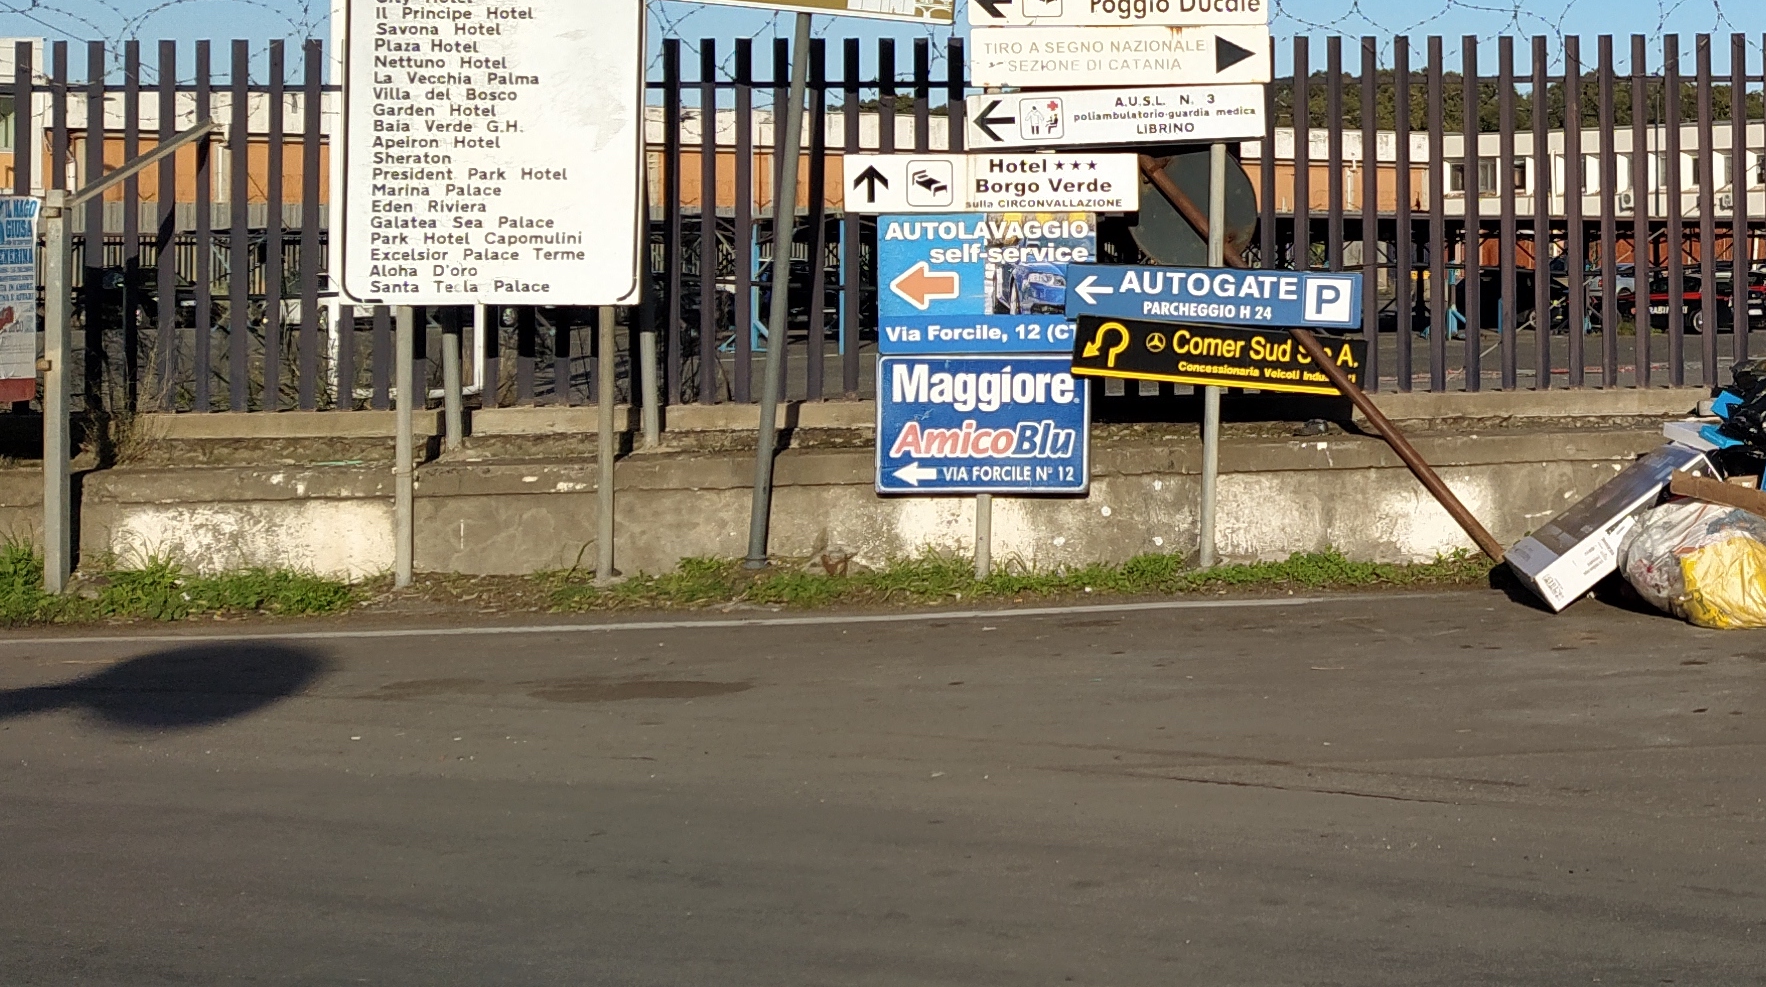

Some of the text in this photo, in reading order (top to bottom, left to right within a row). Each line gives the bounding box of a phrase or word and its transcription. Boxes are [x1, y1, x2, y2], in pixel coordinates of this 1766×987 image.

[377, 7, 533, 22] Il Principe Hotel
[376, 23, 501, 35] Savona Hotel
[375, 38, 479, 53] Plaza Hotel
[984, 40, 1206, 55] TIRO A SEGNO NAZIONALE
[374, 55, 507, 69] Nettuno Hotel
[1008, 58, 1182, 72] SEZIONE DI CATANIA
[374, 71, 539, 85] La Vecchia Palma
[373, 87, 517, 101] Villa del Bosco
[1207, 94, 1215, 104] 3
[373, 103, 496, 117] Garden Hotel
[1216, 107, 1255, 116] medica
[374, 120, 523, 132] Baia Verde G.H.
[1137, 123, 1194, 134] LIBRINO
[372, 136, 500, 150] Apeiron Hotel
[373, 152, 451, 164] Sheraton
[989, 159, 1046, 173] Hotel
[372, 167, 567, 180] President Park Hotel
[372, 184, 501, 196] Marina Palace
[976, 178, 1112, 196] Borgo Verde
[372, 200, 486, 212] Eden Riviera
[966, 199, 1122, 209] sulla CIRCONVALLAZIONE
[371, 216, 554, 229] Galatea Sea Palace
[885, 220, 1089, 240] AUTOLAVAGGIO
[371, 231, 581, 247] Park Hotel Capomulini
[371, 248, 585, 261] Excelsior Palace Terme
[930, 244, 1089, 263] self-service
[369, 265, 477, 277] Aloha D'oro
[370, 281, 419, 293] Santa
[494, 280, 549, 292] Palace
[1119, 270, 1340, 314] AUTOGATE P
[1143, 301, 1272, 320] PARCHEGGIO H 24
[886, 326, 920, 341] Via
[928, 325, 1008, 343] Forcile,
[1016, 324, 1040, 339] 12
[1173, 330, 1242, 358] Comer
[1249, 336, 1291, 362] Sud
[1179, 360, 1259, 378] Concessionaria
[1264, 366, 1299, 380] Veicoli
[892, 364, 1075, 412] Maggiore
[890, 420, 1075, 458] AmicoBlu
[943, 468, 968, 481] VIA
[973, 467, 1030, 481] FORCILE
[1059, 467, 1074, 481] 12
